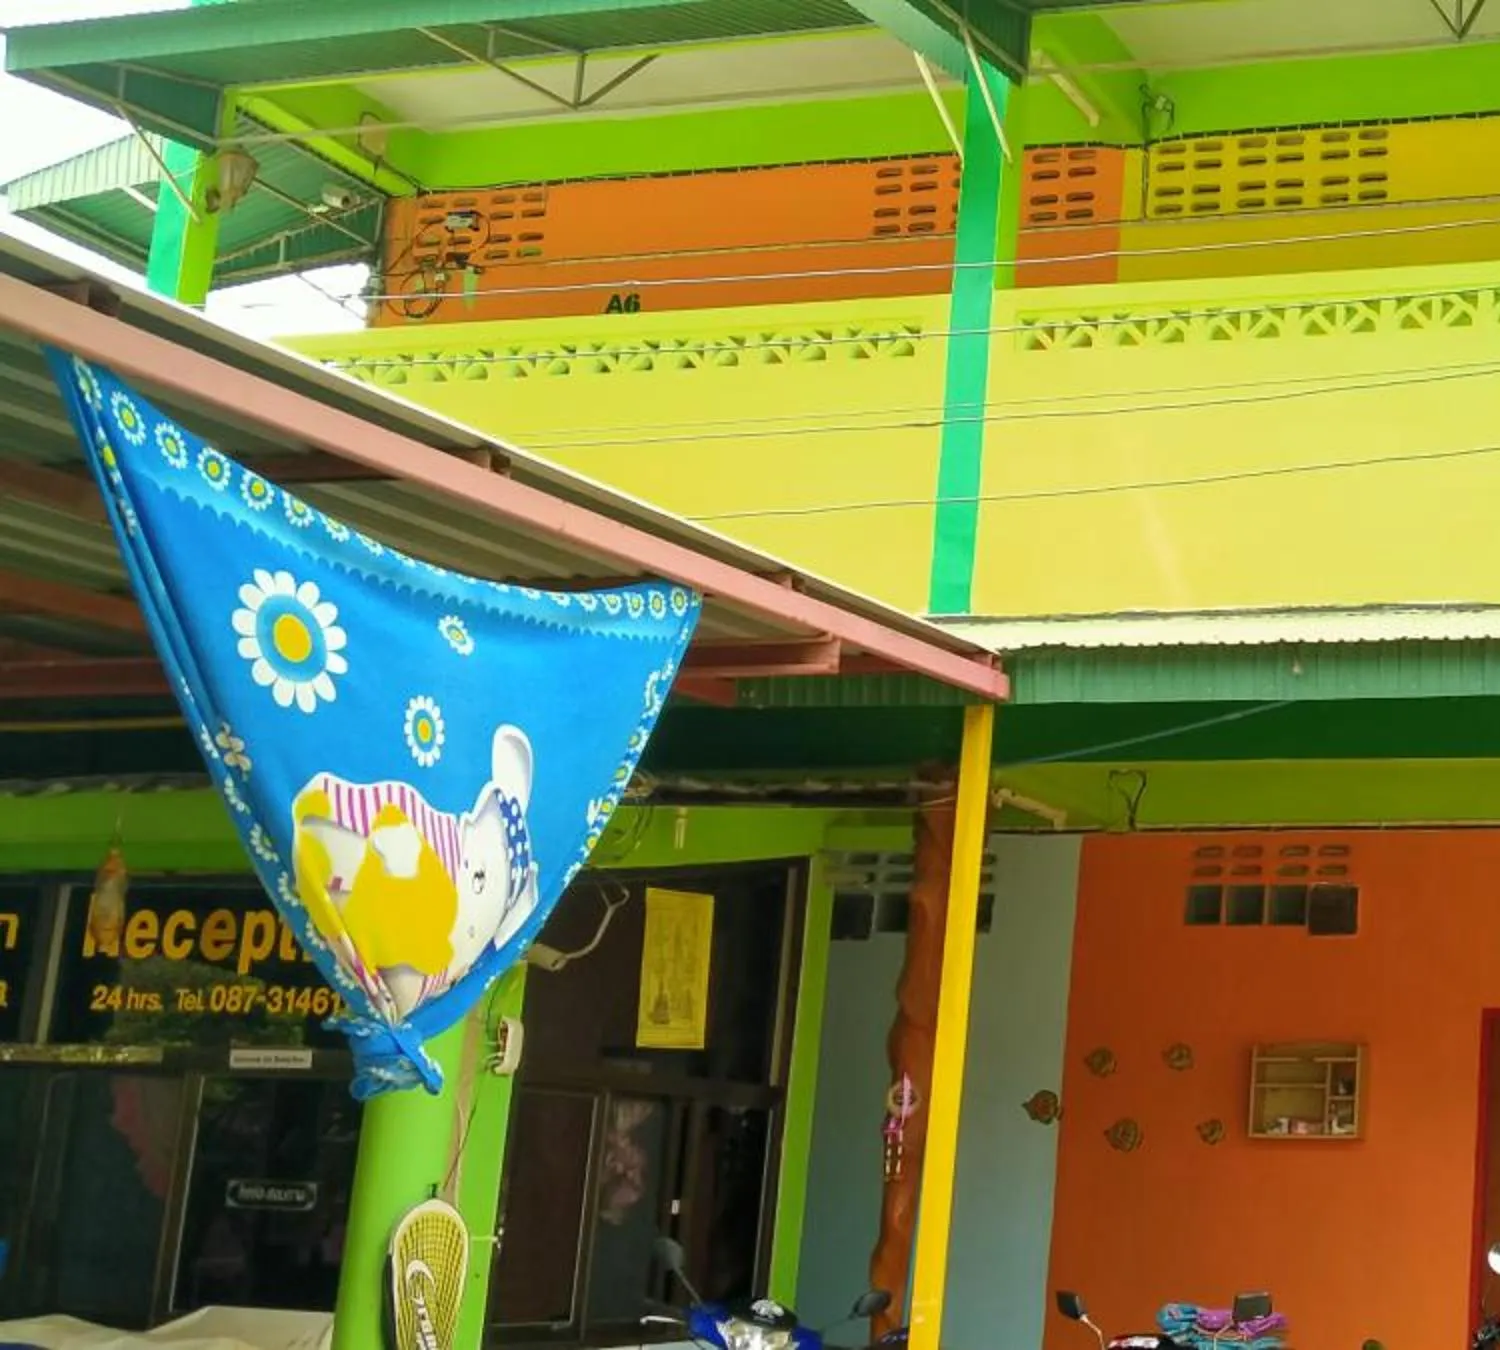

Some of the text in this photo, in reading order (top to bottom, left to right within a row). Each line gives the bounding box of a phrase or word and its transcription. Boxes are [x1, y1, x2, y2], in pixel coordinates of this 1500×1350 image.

[605, 293, 641, 315] A6
[82, 893, 313, 977] ecept
[90, 984, 122, 1011] 24
[209, 984, 350, 1017] 087-31461
